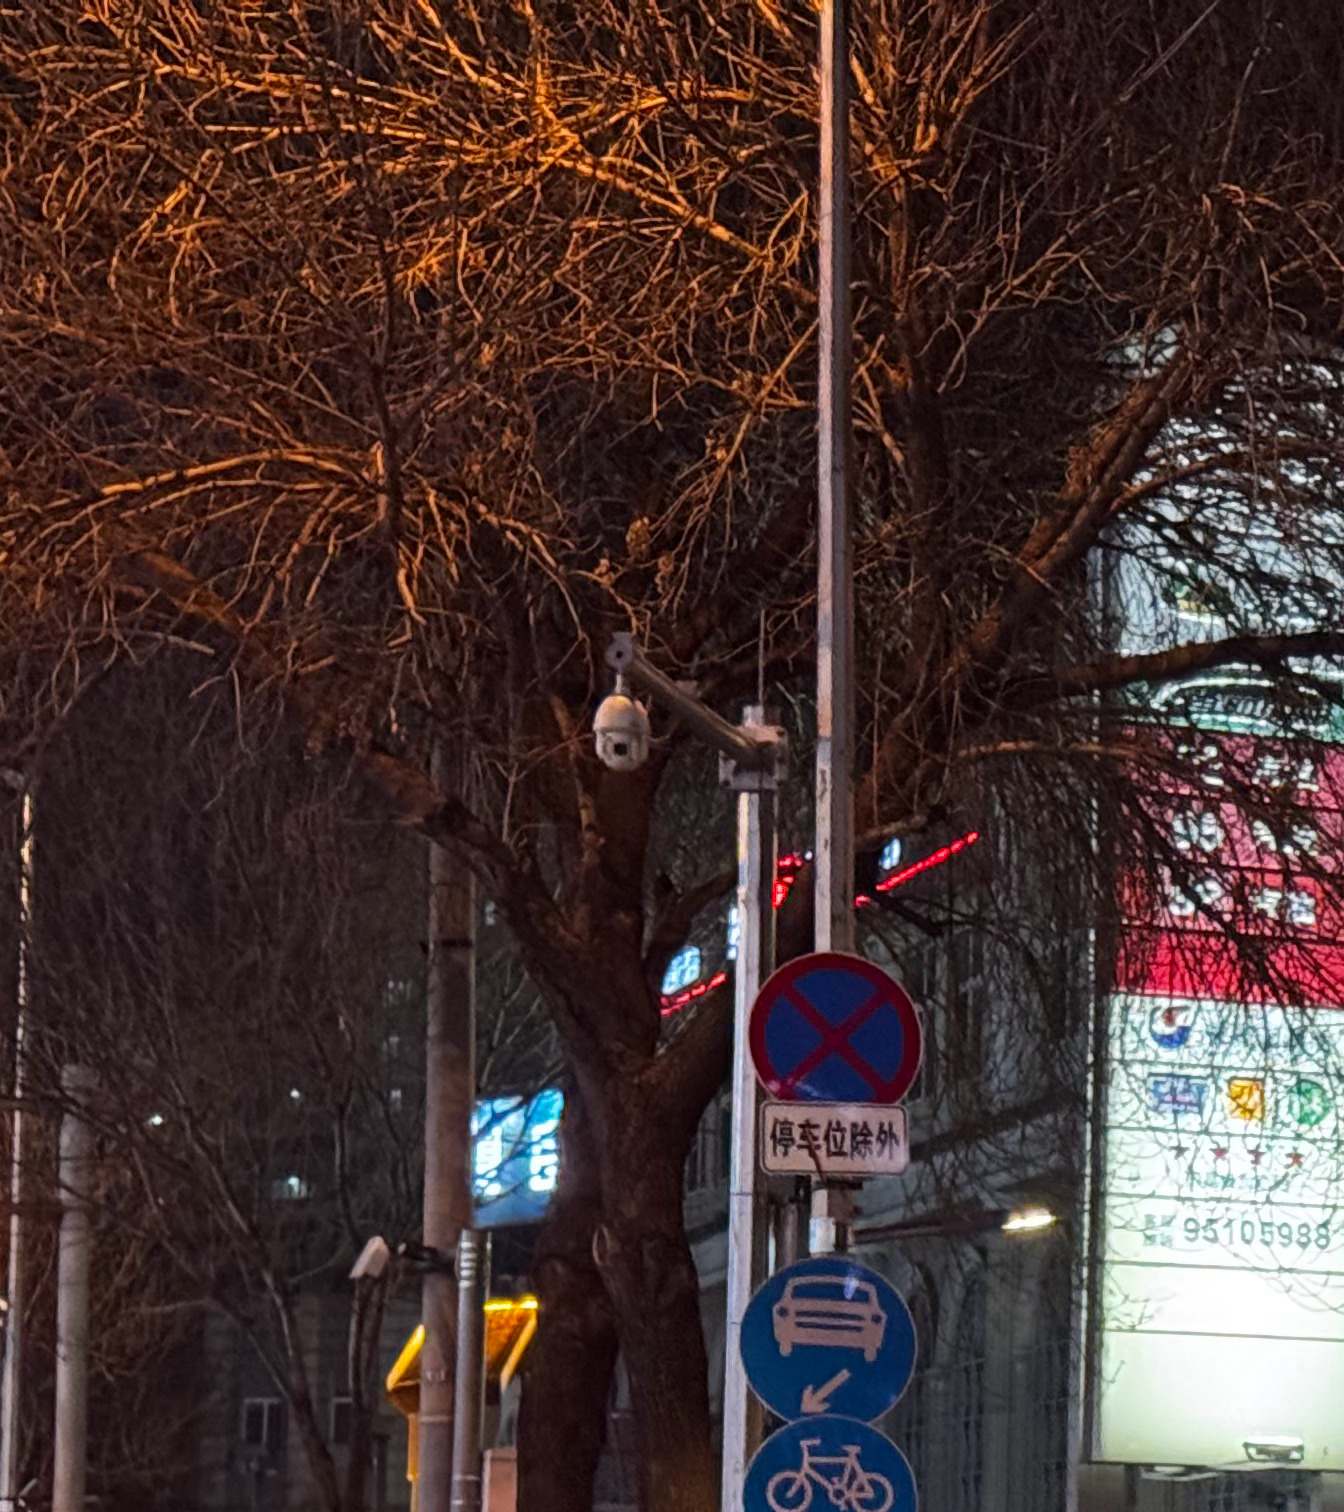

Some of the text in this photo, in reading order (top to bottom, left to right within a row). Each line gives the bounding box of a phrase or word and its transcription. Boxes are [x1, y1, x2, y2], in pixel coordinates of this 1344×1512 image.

[769, 1117, 900, 1159] 停车位除外
[1183, 1216, 1332, 1251] 95105988
